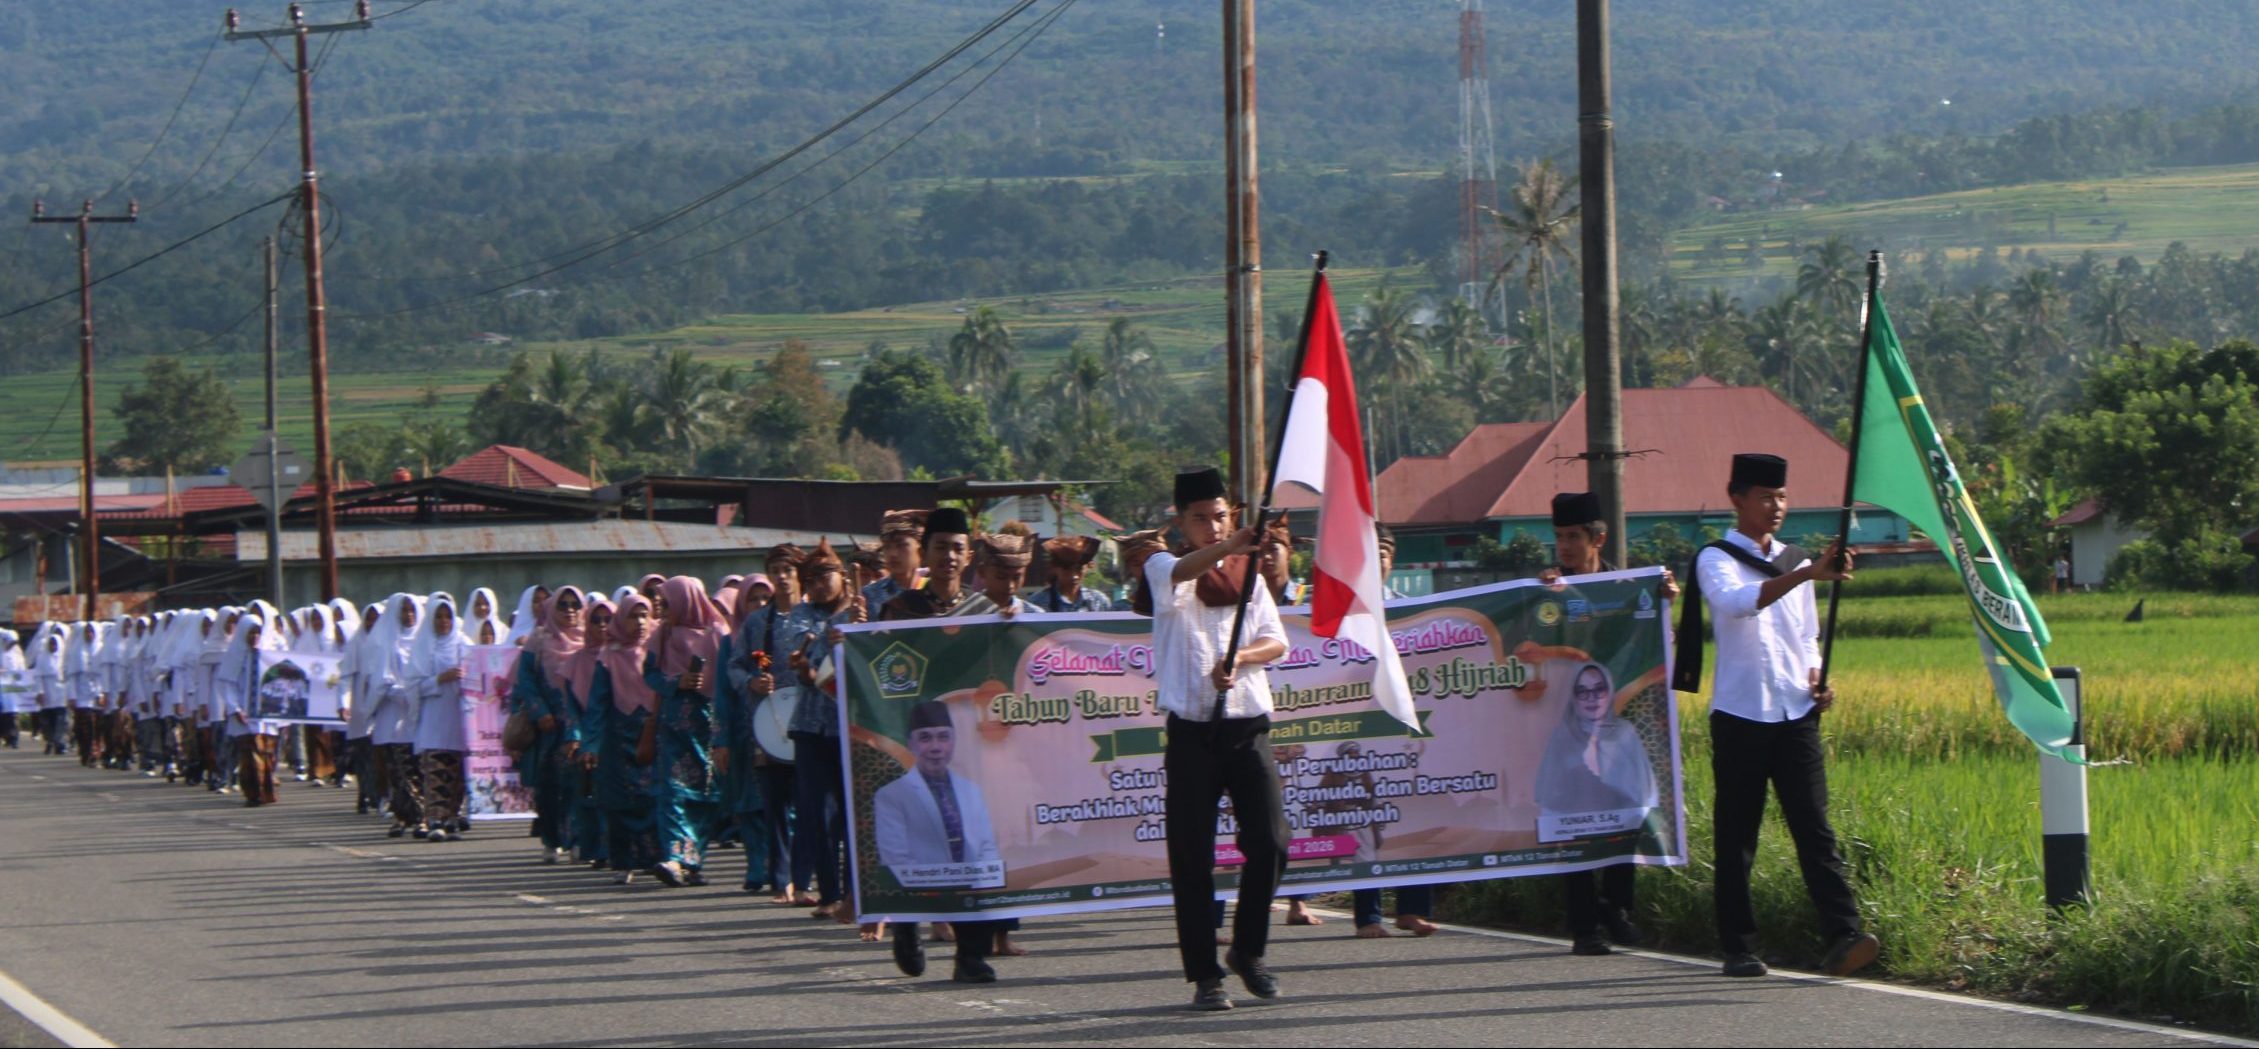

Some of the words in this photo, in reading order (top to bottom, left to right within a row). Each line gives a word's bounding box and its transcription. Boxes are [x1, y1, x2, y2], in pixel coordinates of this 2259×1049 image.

[1027, 645, 1125, 684] Selamat
[1271, 682, 1372, 711] uharram
[1433, 656, 1527, 700] Hijriah
[992, 693, 1071, 726] Tahun
[1074, 689, 1140, 720] Baru
[1268, 723, 1304, 739] nah
[1308, 718, 1363, 736] Datar
[1296, 751, 1410, 777] Perubahan
[1110, 767, 1156, 790] Satu
[1374, 777, 1414, 800] dan
[1415, 770, 1498, 796] Bersatu
[1035, 796, 1139, 825] Berakhlak
[1301, 802, 1400, 829] Islamiyah
[1135, 820, 1167, 842] dal
[1303, 840, 1336, 854] 2026
